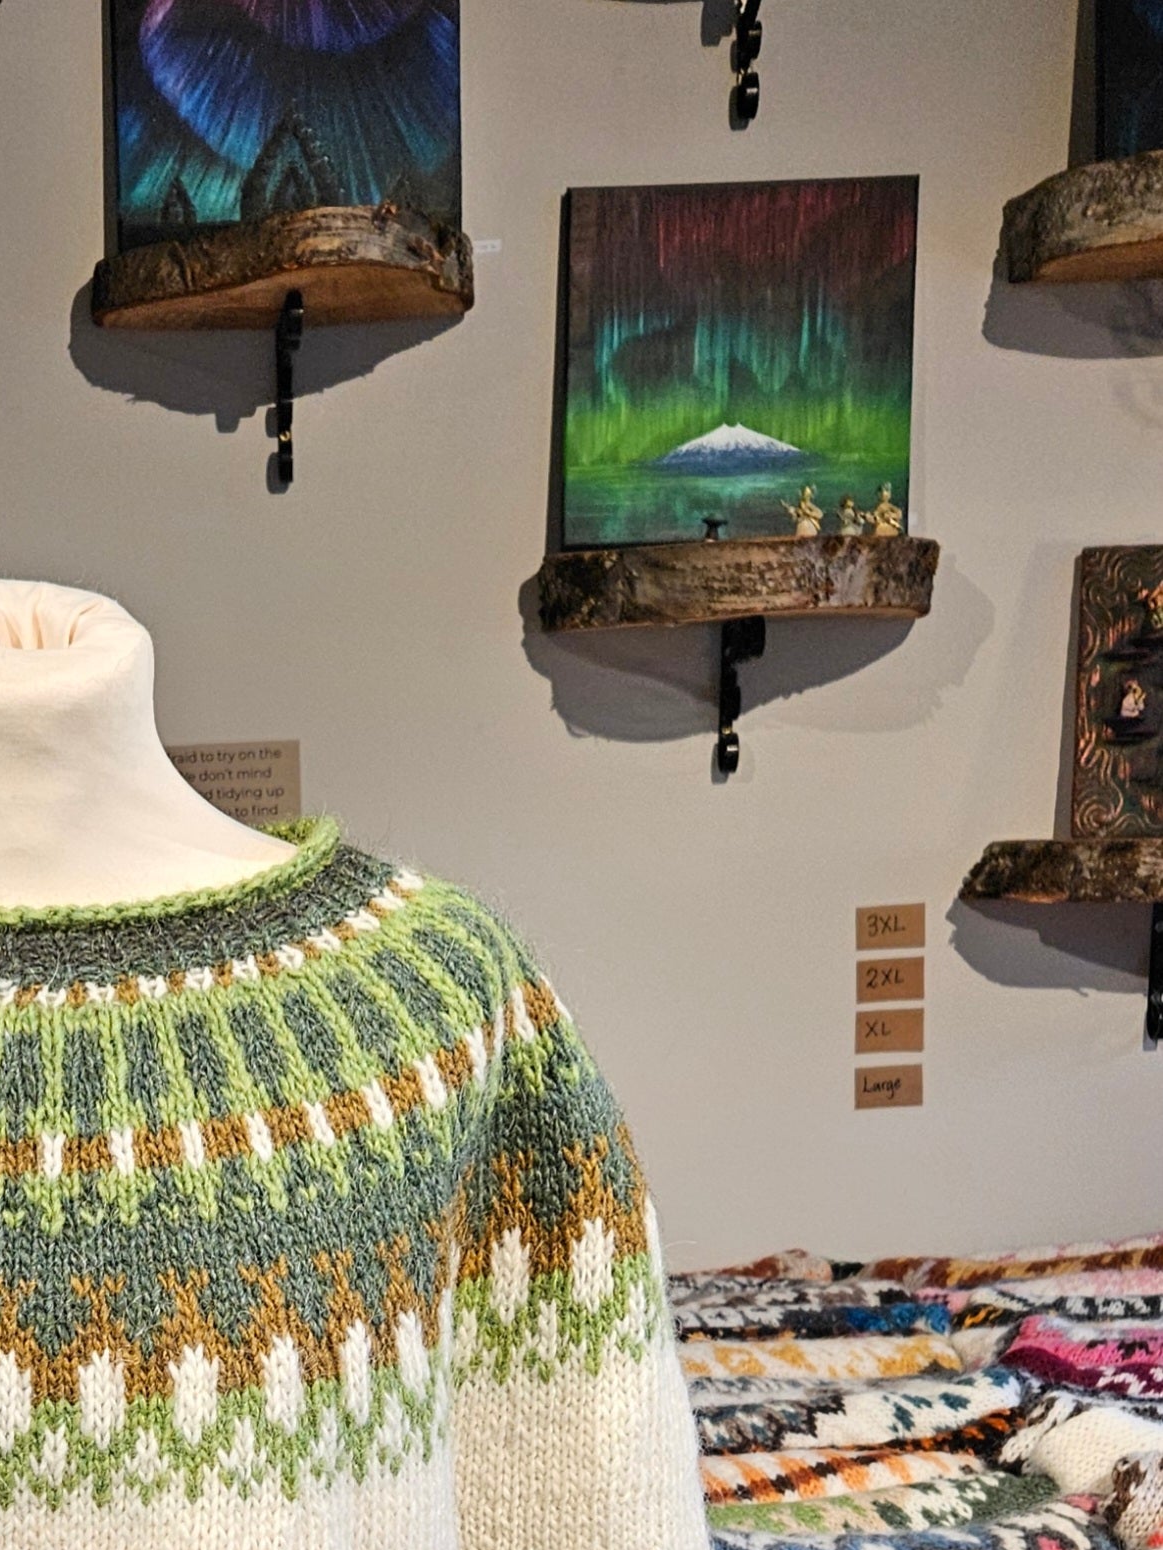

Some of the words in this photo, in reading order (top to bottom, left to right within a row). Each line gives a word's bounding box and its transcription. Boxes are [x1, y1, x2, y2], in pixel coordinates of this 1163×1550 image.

[200, 751, 214, 763] to
[217, 750, 236, 764] try
[239, 749, 255, 760] on
[259, 747, 282, 760] the
[199, 768, 233, 782] don't
[237, 767, 272, 779] mind
[216, 786, 263, 801] tidying
[266, 787, 285, 799] up
[235, 806, 249, 818] to
[251, 804, 279, 817] find
[866, 914, 905, 937] 3XL
[866, 967, 905, 989] 2XL
[864, 1020, 892, 1039] XL
[862, 1076, 902, 1100] Large
